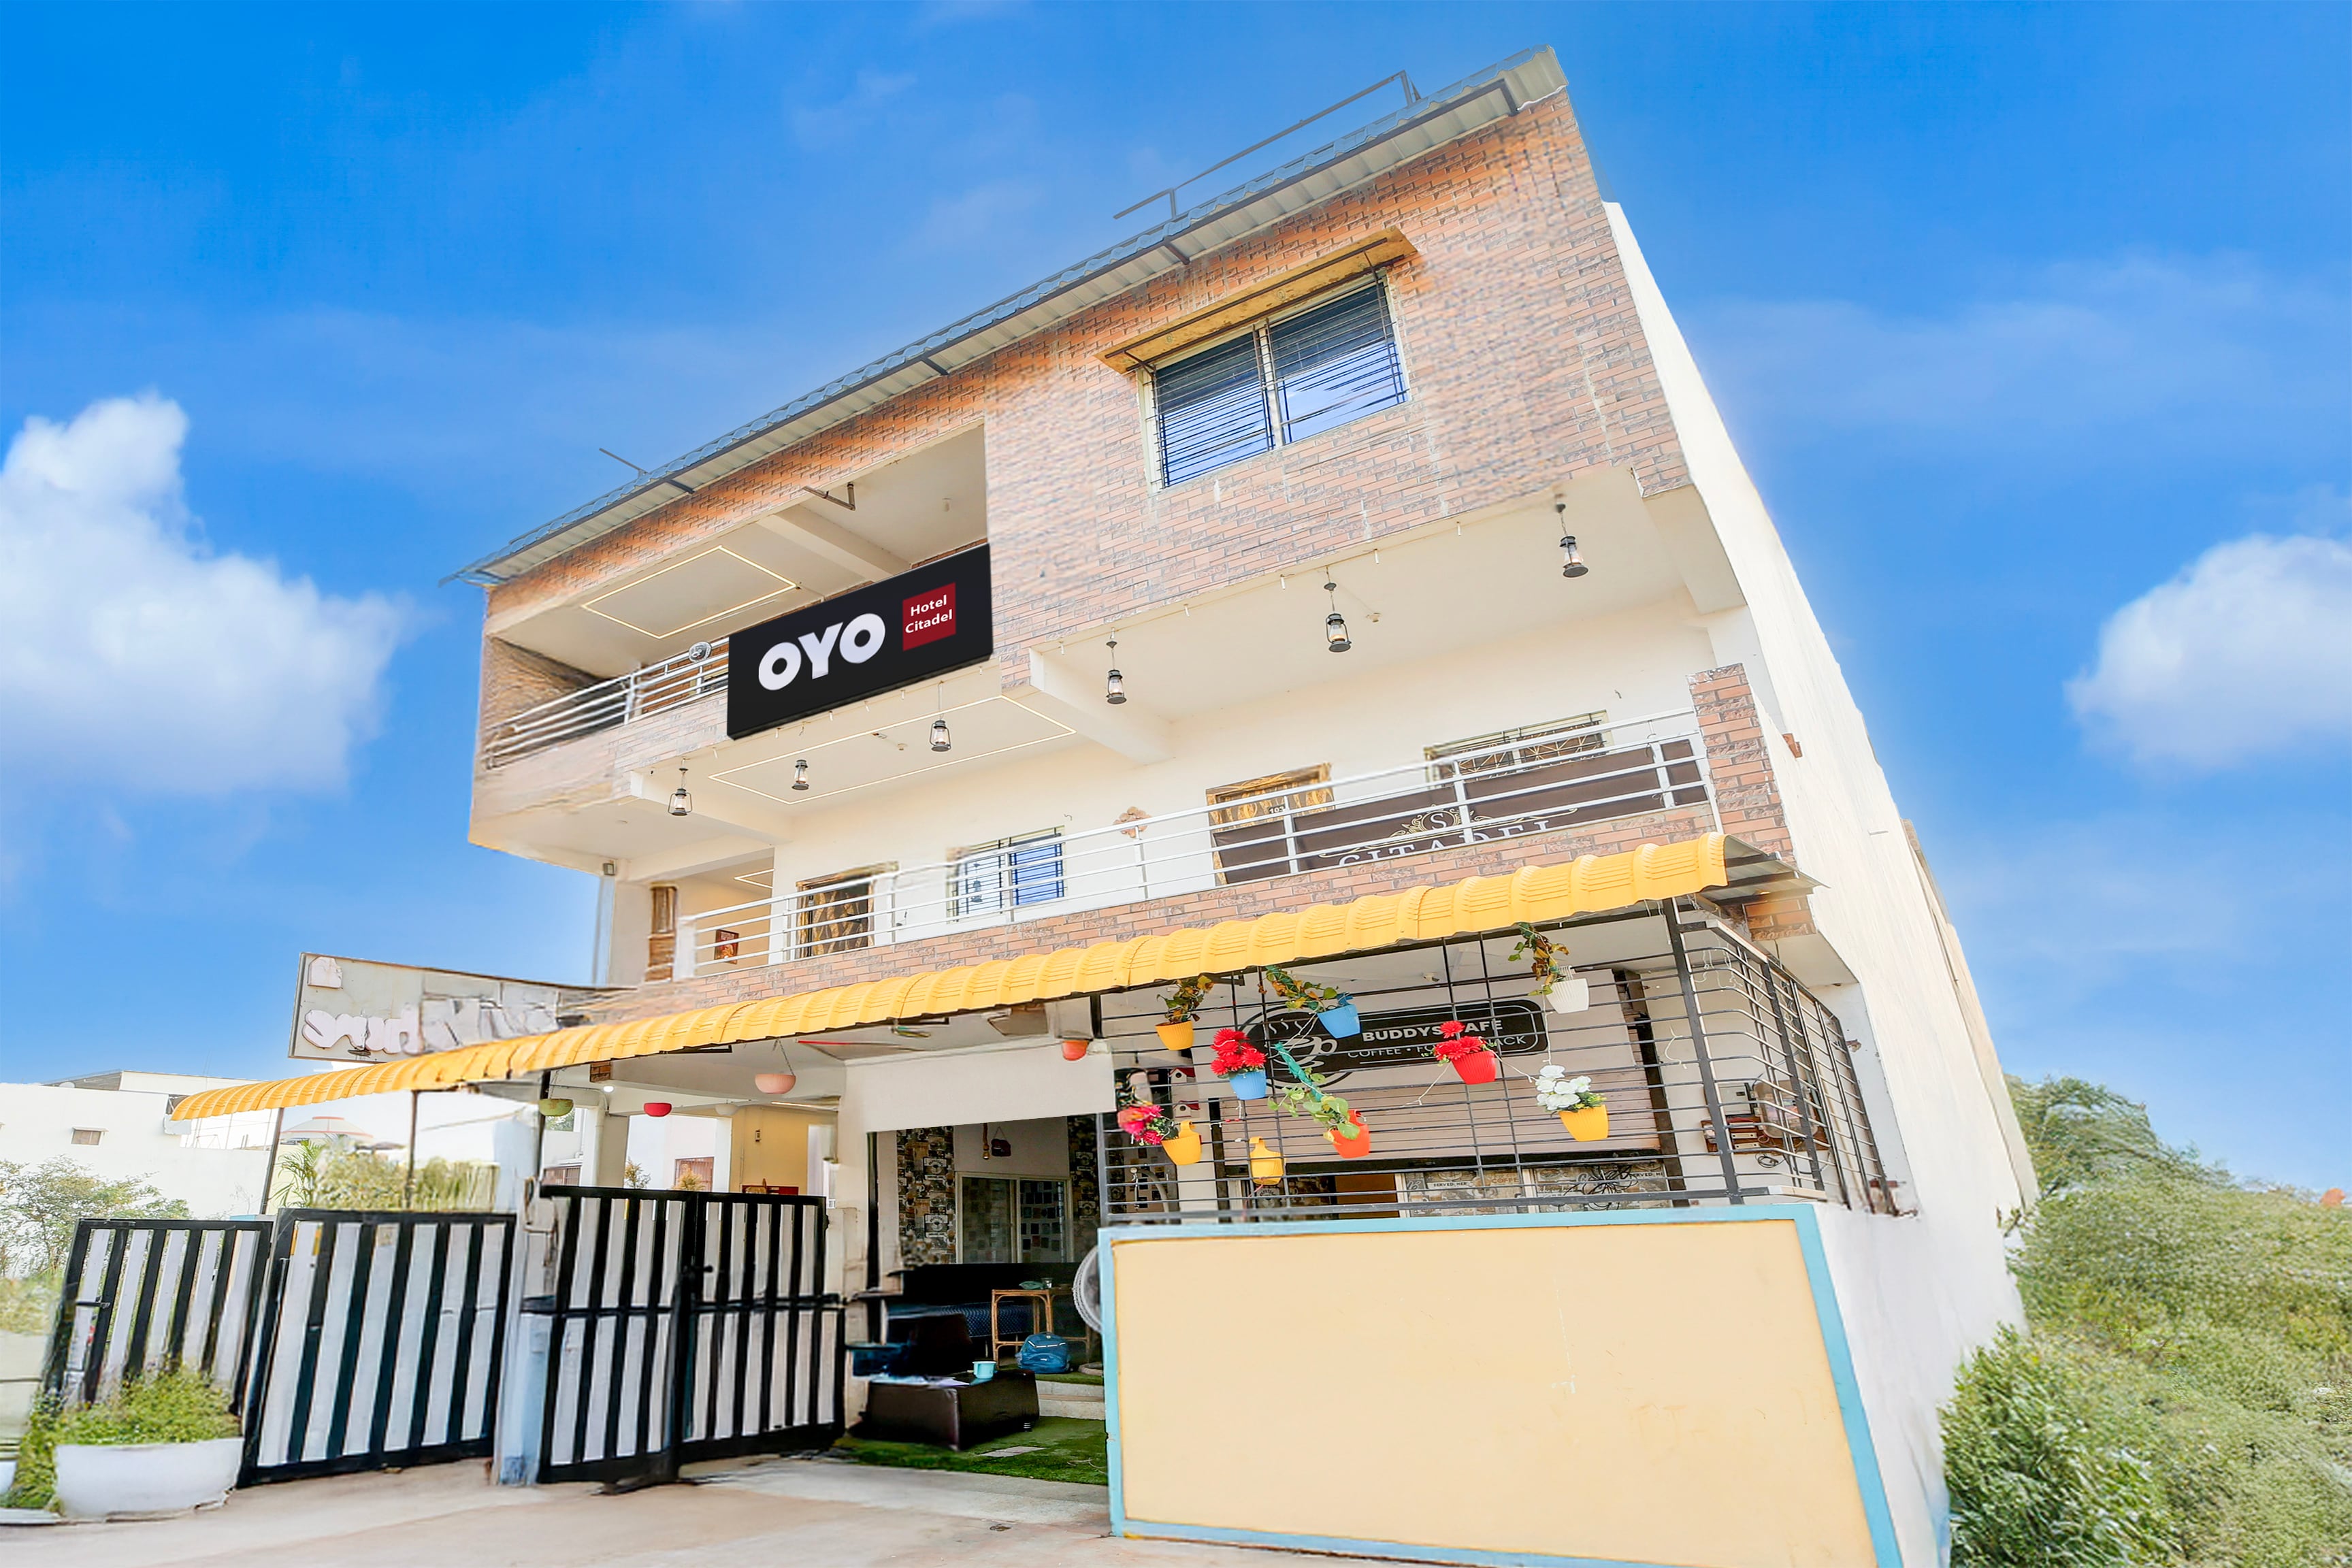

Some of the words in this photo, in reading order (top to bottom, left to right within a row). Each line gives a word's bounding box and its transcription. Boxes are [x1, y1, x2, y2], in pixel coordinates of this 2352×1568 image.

[911, 594, 947, 617] Hotel
[905, 609, 953, 634] Citadel
[758, 613, 885, 691] OYO
[1269, 806, 1285, 814] 103
[1362, 1026, 1442, 1042] BUDDYS
[1463, 1019, 1503, 1033] AFE
[1348, 1048, 1402, 1058] COFFEE
[1488, 1035, 1526, 1046] ACK
